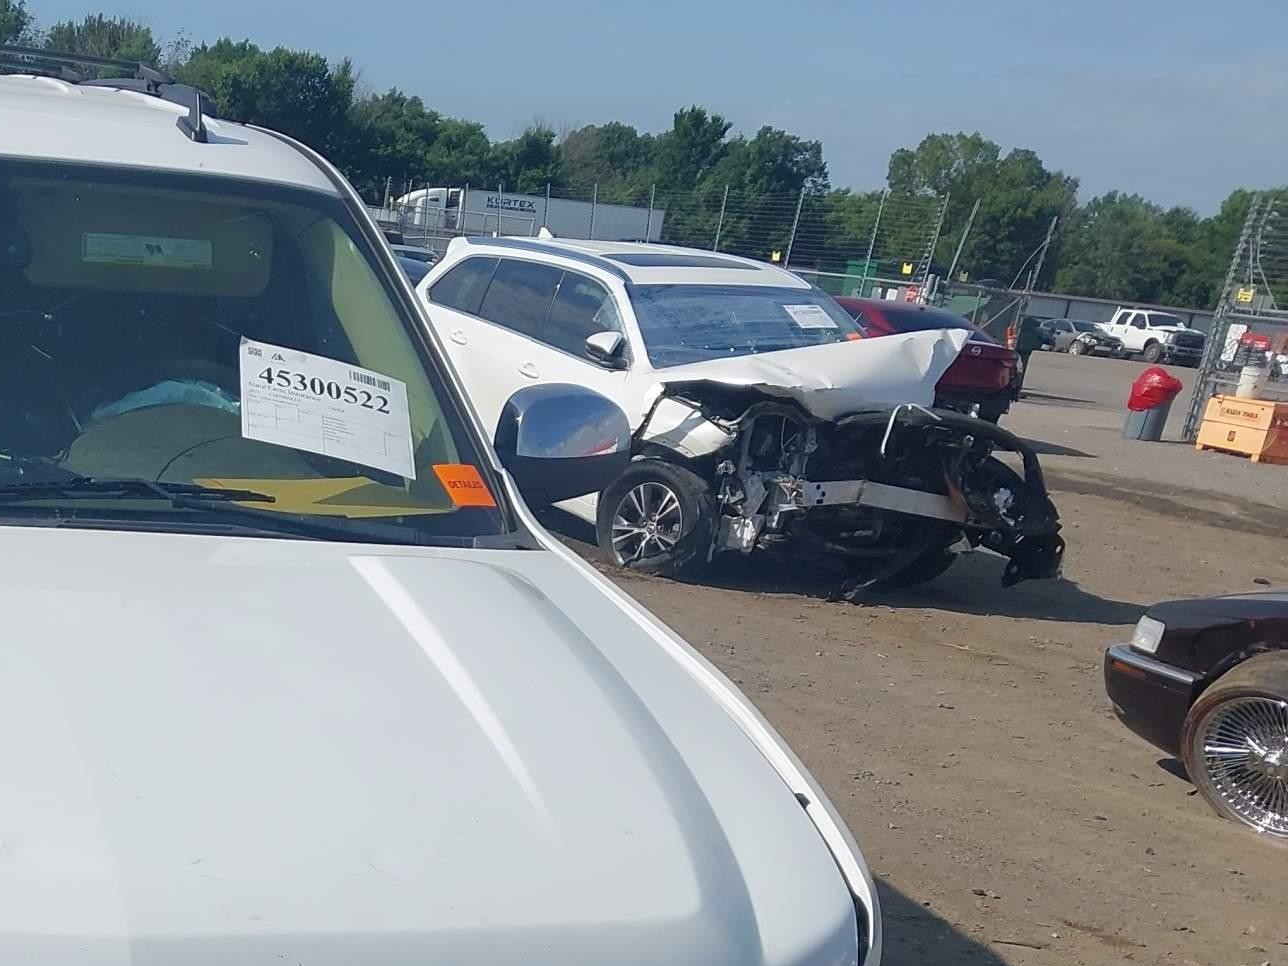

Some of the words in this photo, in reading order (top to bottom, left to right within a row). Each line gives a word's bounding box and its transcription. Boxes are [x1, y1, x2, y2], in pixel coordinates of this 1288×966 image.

[487, 196, 536, 209] KURTEX
[259, 366, 391, 414] 45300522
[448, 480, 483, 489] DETAILED
